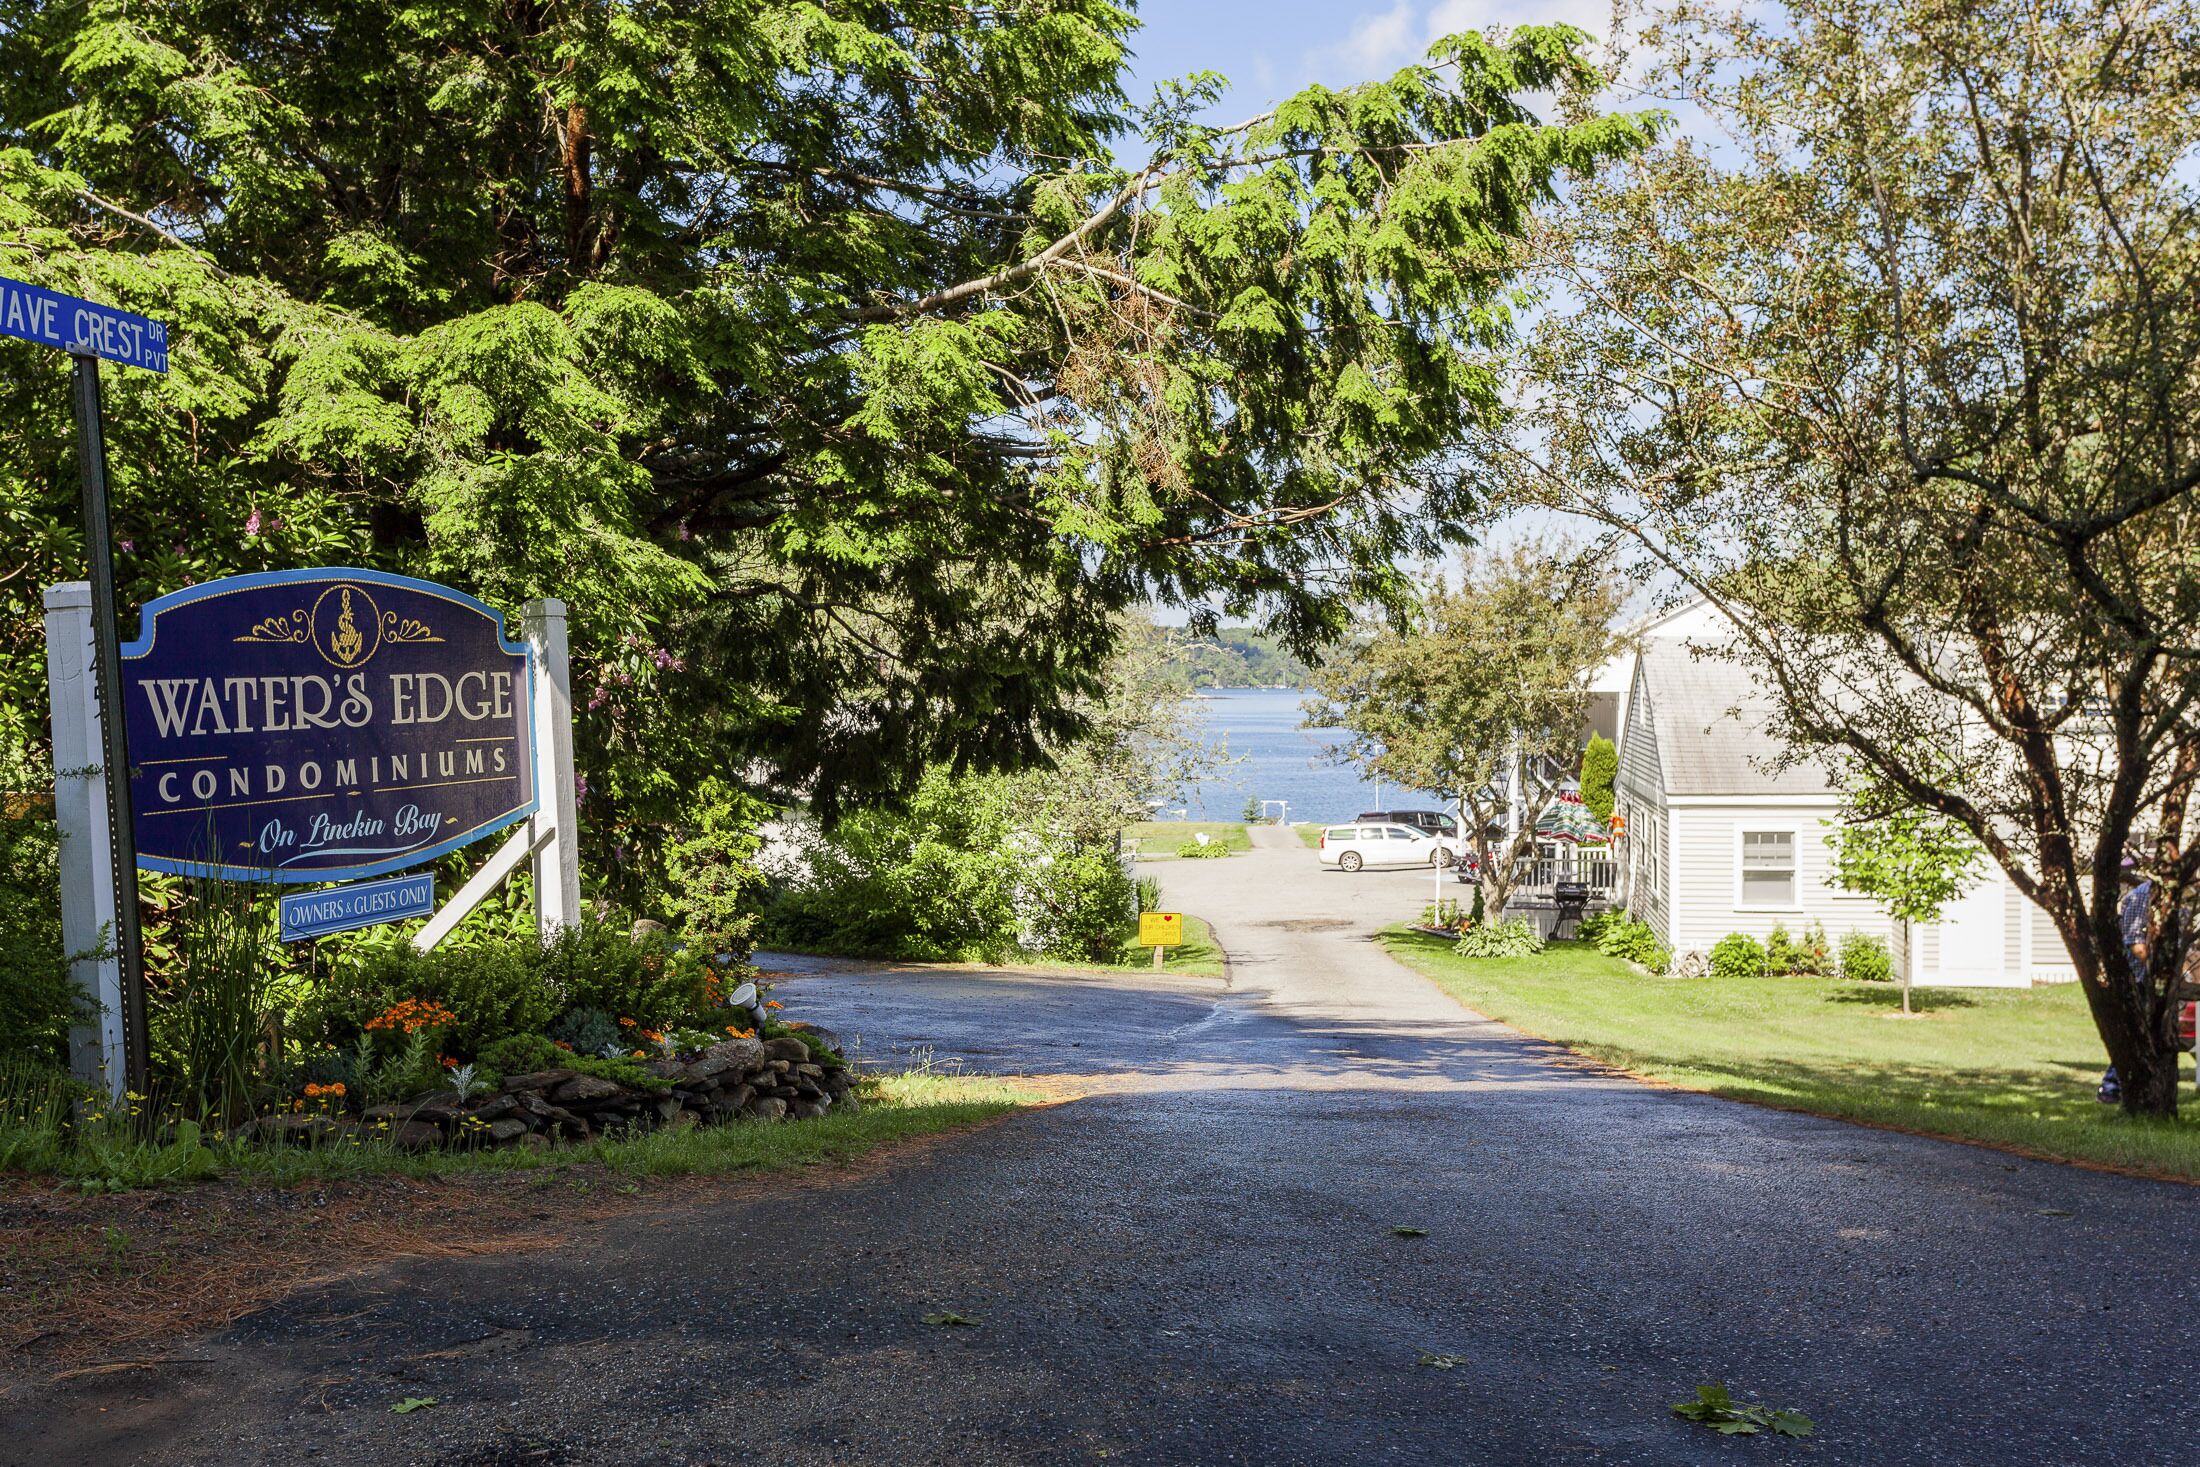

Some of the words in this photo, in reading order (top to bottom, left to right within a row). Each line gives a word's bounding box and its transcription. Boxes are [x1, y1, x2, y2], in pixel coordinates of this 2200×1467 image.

[0, 286, 60, 340] AVE
[74, 308, 143, 361] CREST
[148, 320, 163, 343] DR
[145, 348, 168, 372] PVT
[138, 671, 373, 738] WATER'S
[389, 670, 513, 725] EDGE
[158, 747, 506, 803] CONDOMINIUMS
[259, 818, 297, 853] On
[300, 809, 386, 847] Linekin
[394, 803, 442, 843] Bay
[289, 899, 344, 926] OWNERS
[345, 902, 352, 913] &
[354, 890, 396, 915] GUESTS
[400, 884, 428, 905] ONLY
